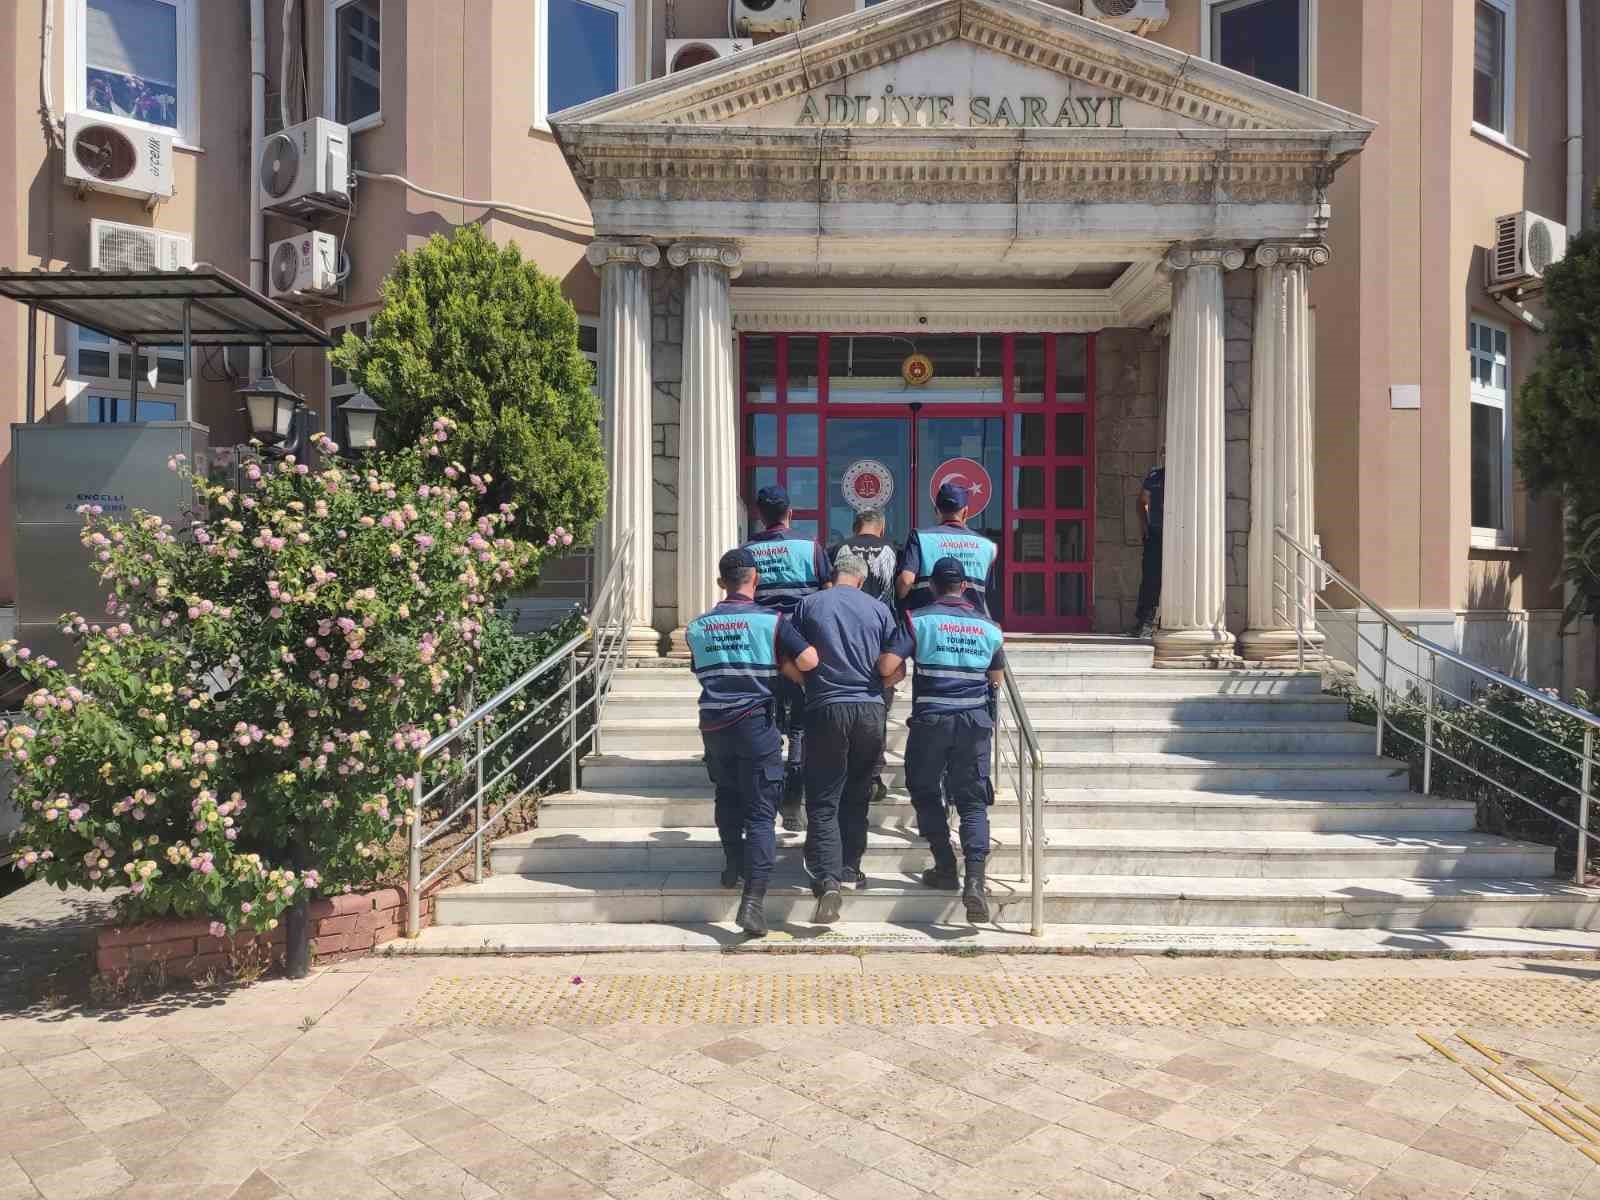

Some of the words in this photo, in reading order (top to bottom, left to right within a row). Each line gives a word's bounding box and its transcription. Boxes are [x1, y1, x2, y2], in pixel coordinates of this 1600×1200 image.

[795, 84, 957, 126] ADLİYE
[969, 96, 1123, 127] SARAYI
[704, 621, 750, 632] JANDARMA
[937, 623, 985, 636] JANDARMA
[946, 636, 977, 645] TOURISM
